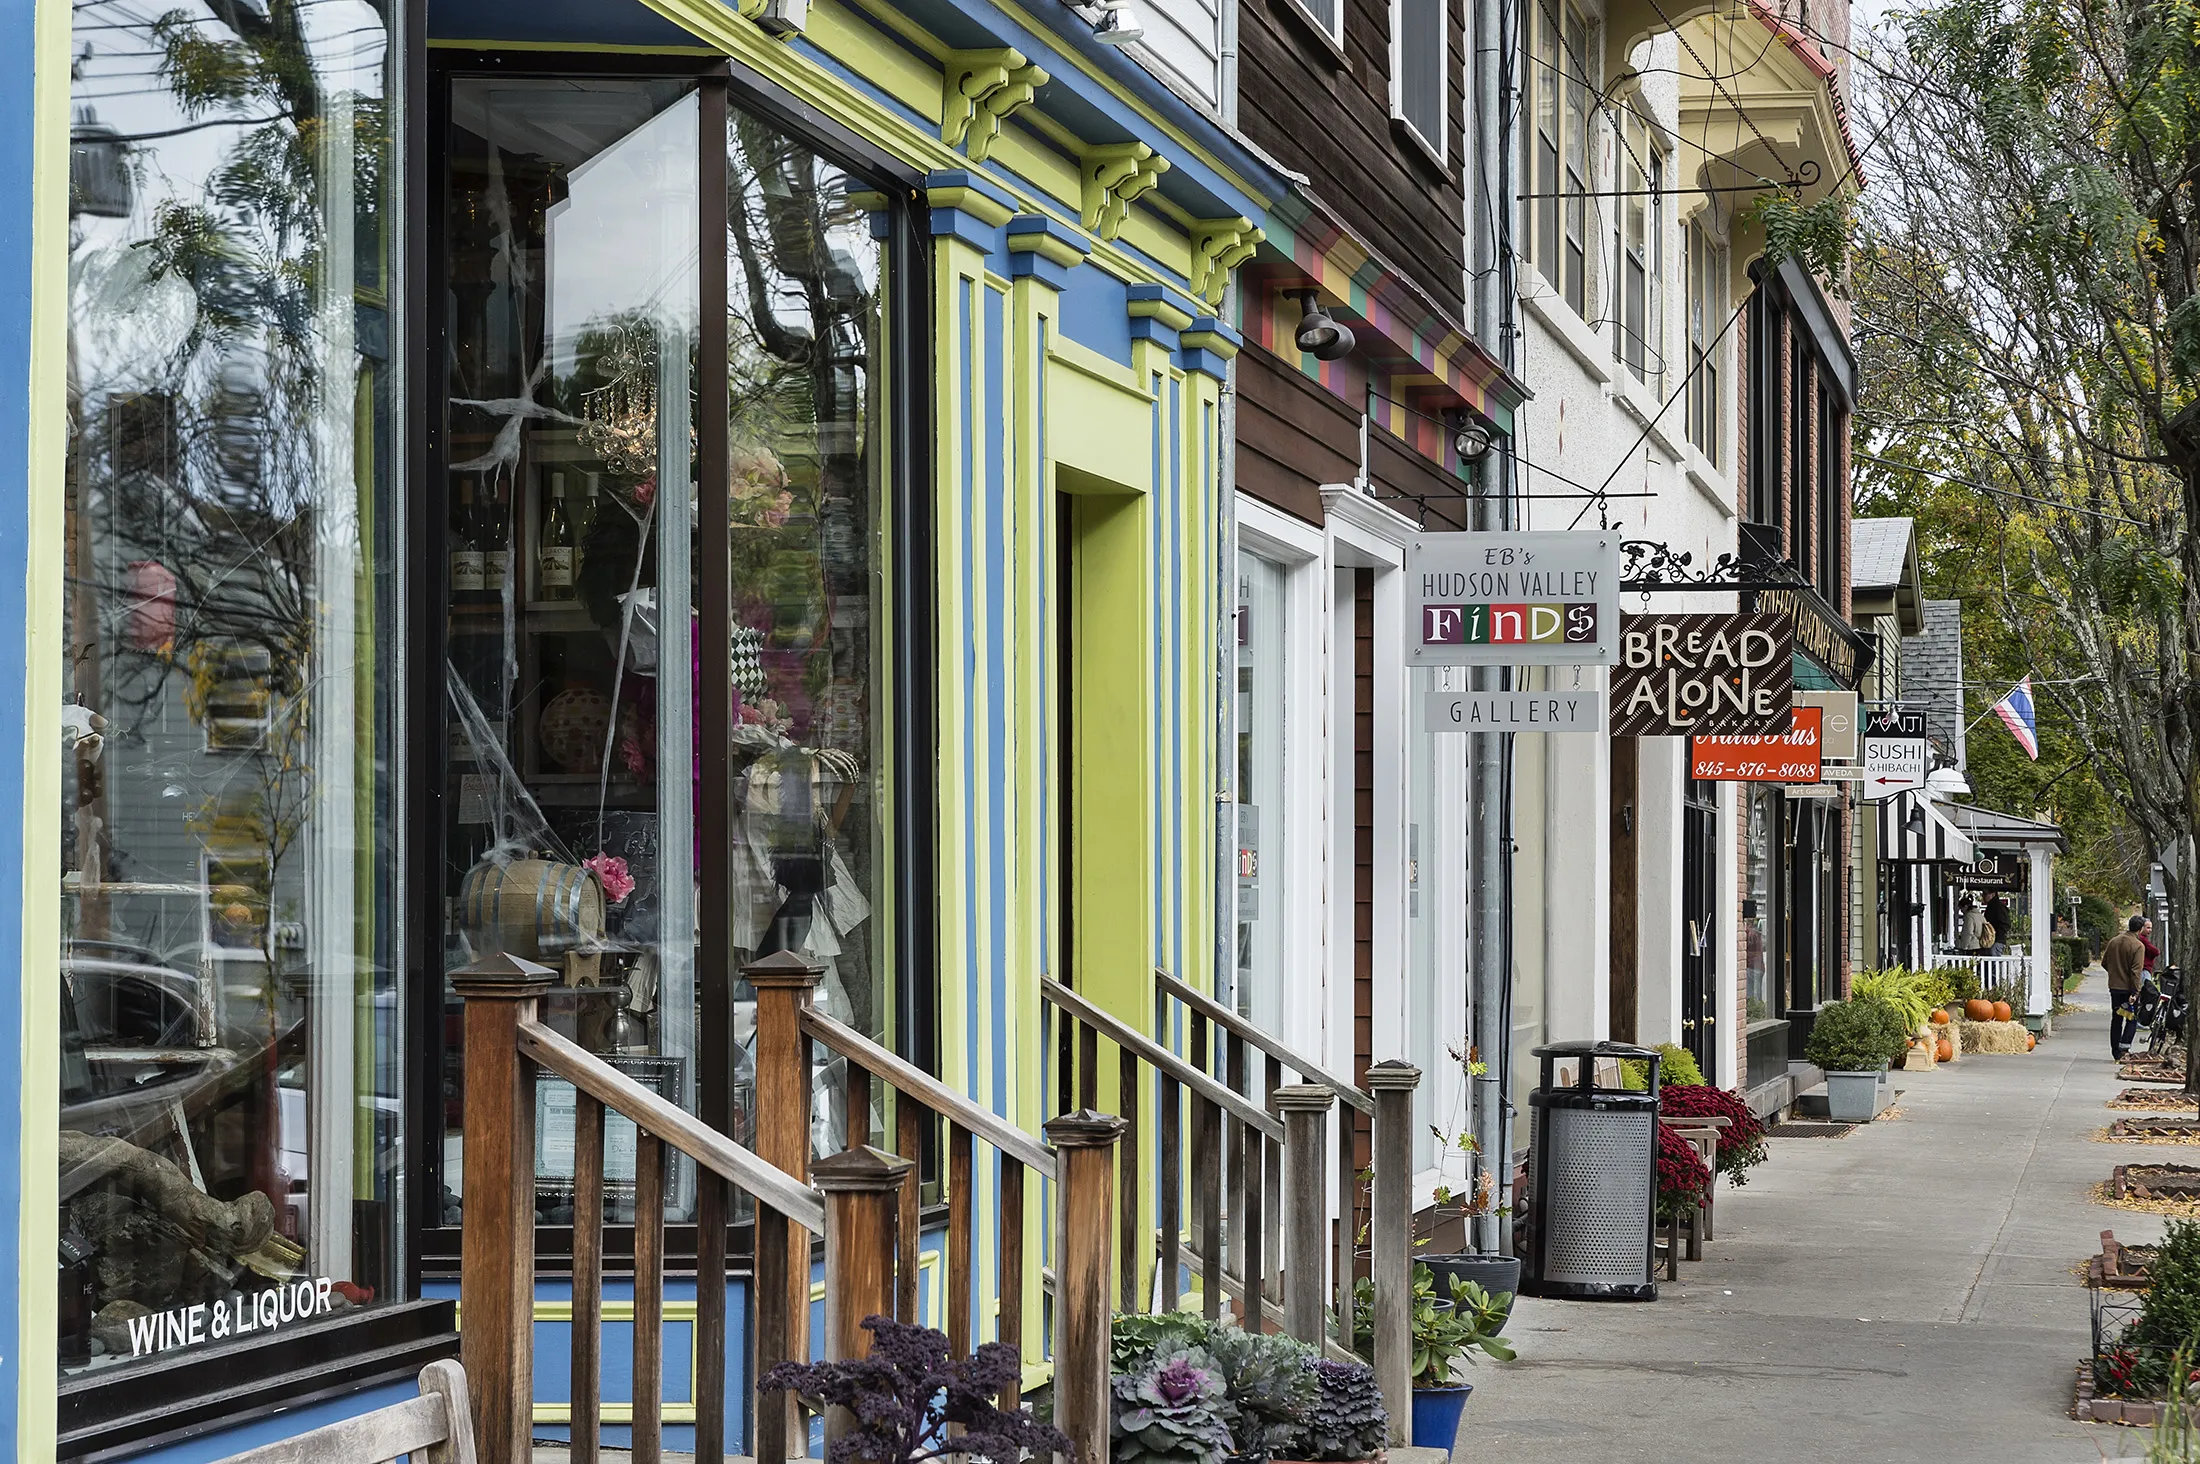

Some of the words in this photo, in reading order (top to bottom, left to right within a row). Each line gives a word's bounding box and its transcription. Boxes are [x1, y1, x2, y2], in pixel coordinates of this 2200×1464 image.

[1485, 548, 1534, 566] EB's
[1423, 573, 1509, 597] HUDSON
[1519, 572, 1597, 596] VALLEY
[1626, 624, 1776, 668] BREAD
[1626, 668, 1774, 726] ALONE
[1450, 700, 1577, 722] GALLERY
[1868, 743, 1922, 760] SUSHI
[1823, 769, 1854, 777] AVEDA
[1877, 762, 1921, 774] HIBACHI
[1791, 788, 1804, 796] Art
[1805, 787, 1831, 796] Gallery
[1969, 877, 2003, 885] Restaurant
[127, 1302, 206, 1357] WINE
[211, 1299, 230, 1339] &
[236, 1277, 333, 1334] LIQUOR
